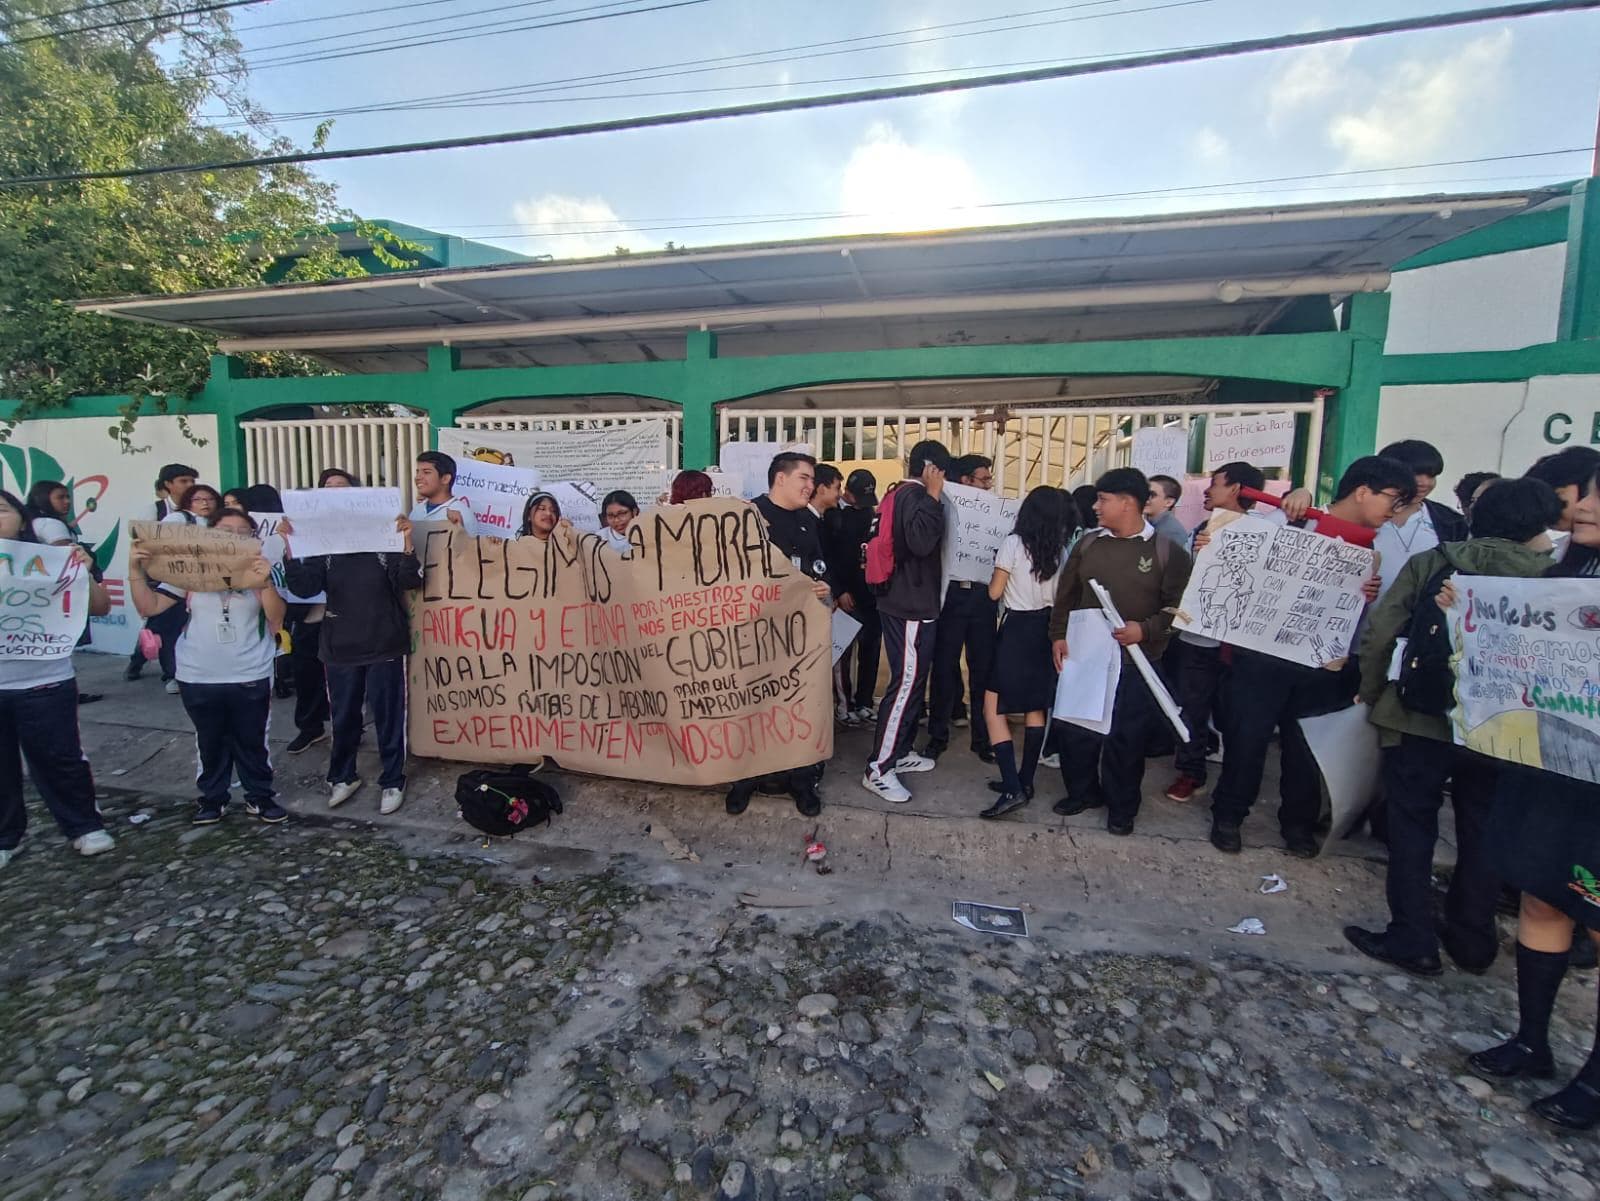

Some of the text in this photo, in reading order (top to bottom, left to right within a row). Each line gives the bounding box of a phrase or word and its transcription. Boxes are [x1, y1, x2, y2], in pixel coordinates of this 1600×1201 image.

[1213, 421, 1266, 438] Justicia
[1209, 449, 1224, 462] Los
[422, 529, 612, 604] ELEGIMOS
[654, 507, 790, 592] MORAL
[1274, 528, 1317, 551] DEFENDER
[1314, 539, 1326, 554] A
[1306, 547, 1322, 568] ES
[632, 583, 783, 621] POR MAESTROS QUE
[638, 602, 762, 637] NOS ENSEÑEN
[422, 604, 517, 653] ANTIGUA
[425, 656, 451, 690] NO
[457, 656, 473, 681] A
[479, 652, 517, 680] LA
[640, 642, 664, 658] DEL
[666, 610, 807, 681] GOBIERNO
[427, 695, 447, 715] NO
[447, 683, 507, 711] SOMOS
[579, 694, 599, 720] DE
[679, 668, 801, 720] IMPROVISADOS
[673, 673, 739, 699] PARA QUE
[665, 700, 813, 767] NOSOTROS
